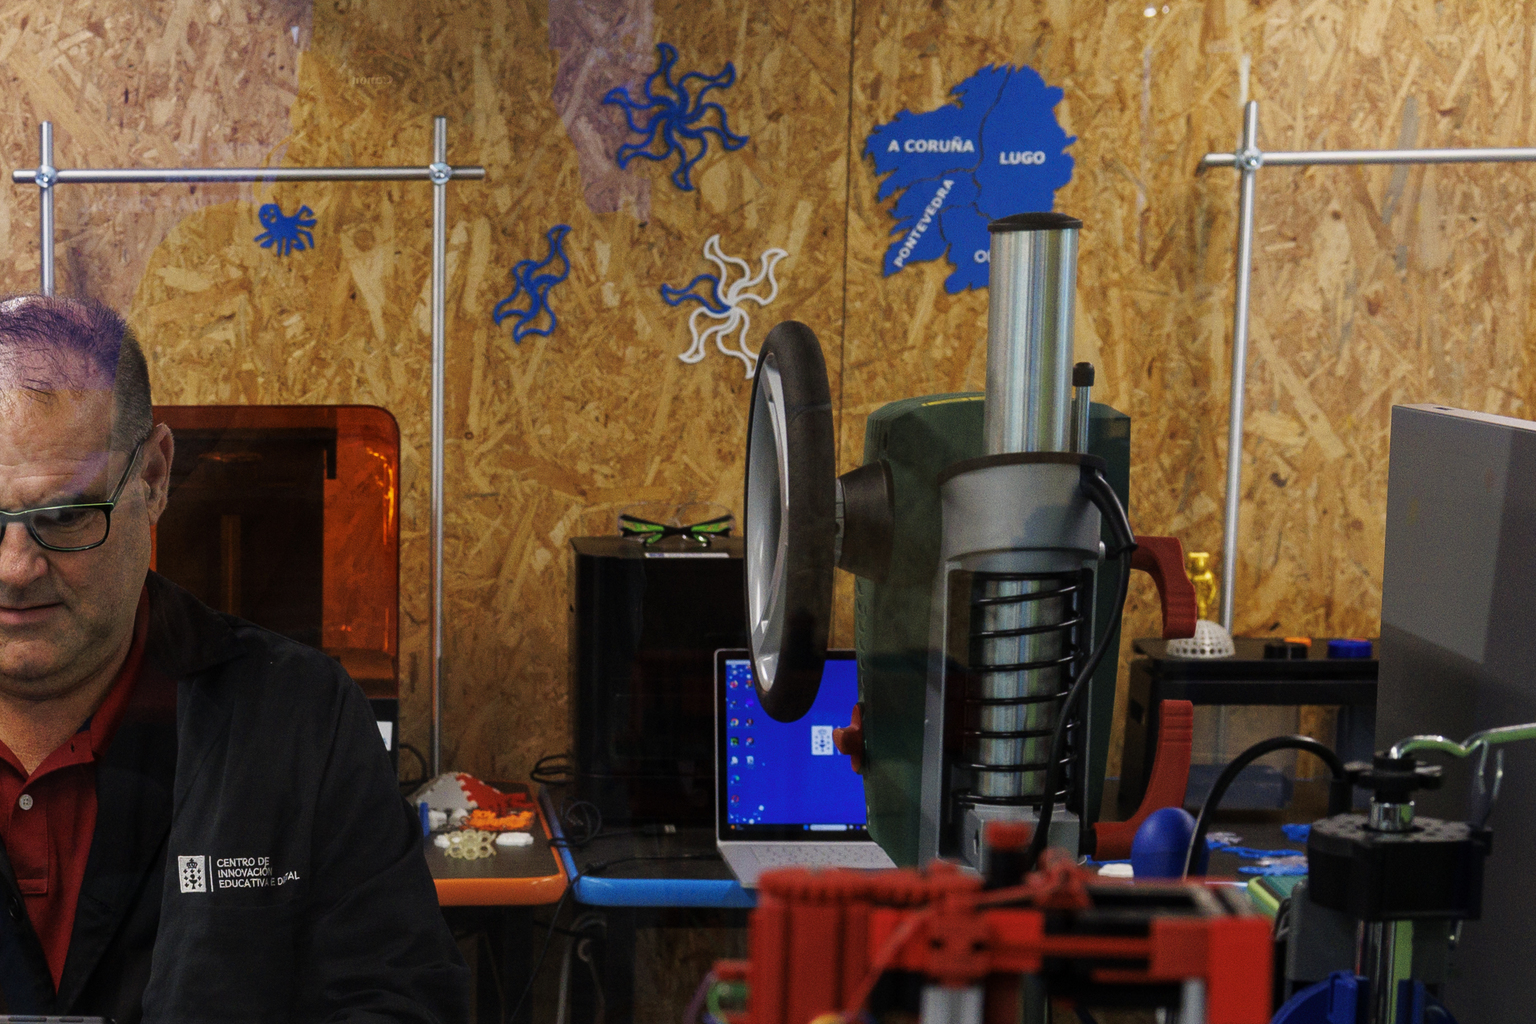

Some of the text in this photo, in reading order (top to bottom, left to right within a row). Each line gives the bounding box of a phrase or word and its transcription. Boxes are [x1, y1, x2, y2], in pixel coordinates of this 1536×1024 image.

[887, 136, 975, 153] A CORUÑA
[999, 150, 1046, 165] LUGO
[893, 178, 955, 268] PONTEVEDRA
[216, 856, 270, 867] CENTRO DE
[219, 878, 269, 888] EDUCATIVA
[270, 877, 276, 887] E
